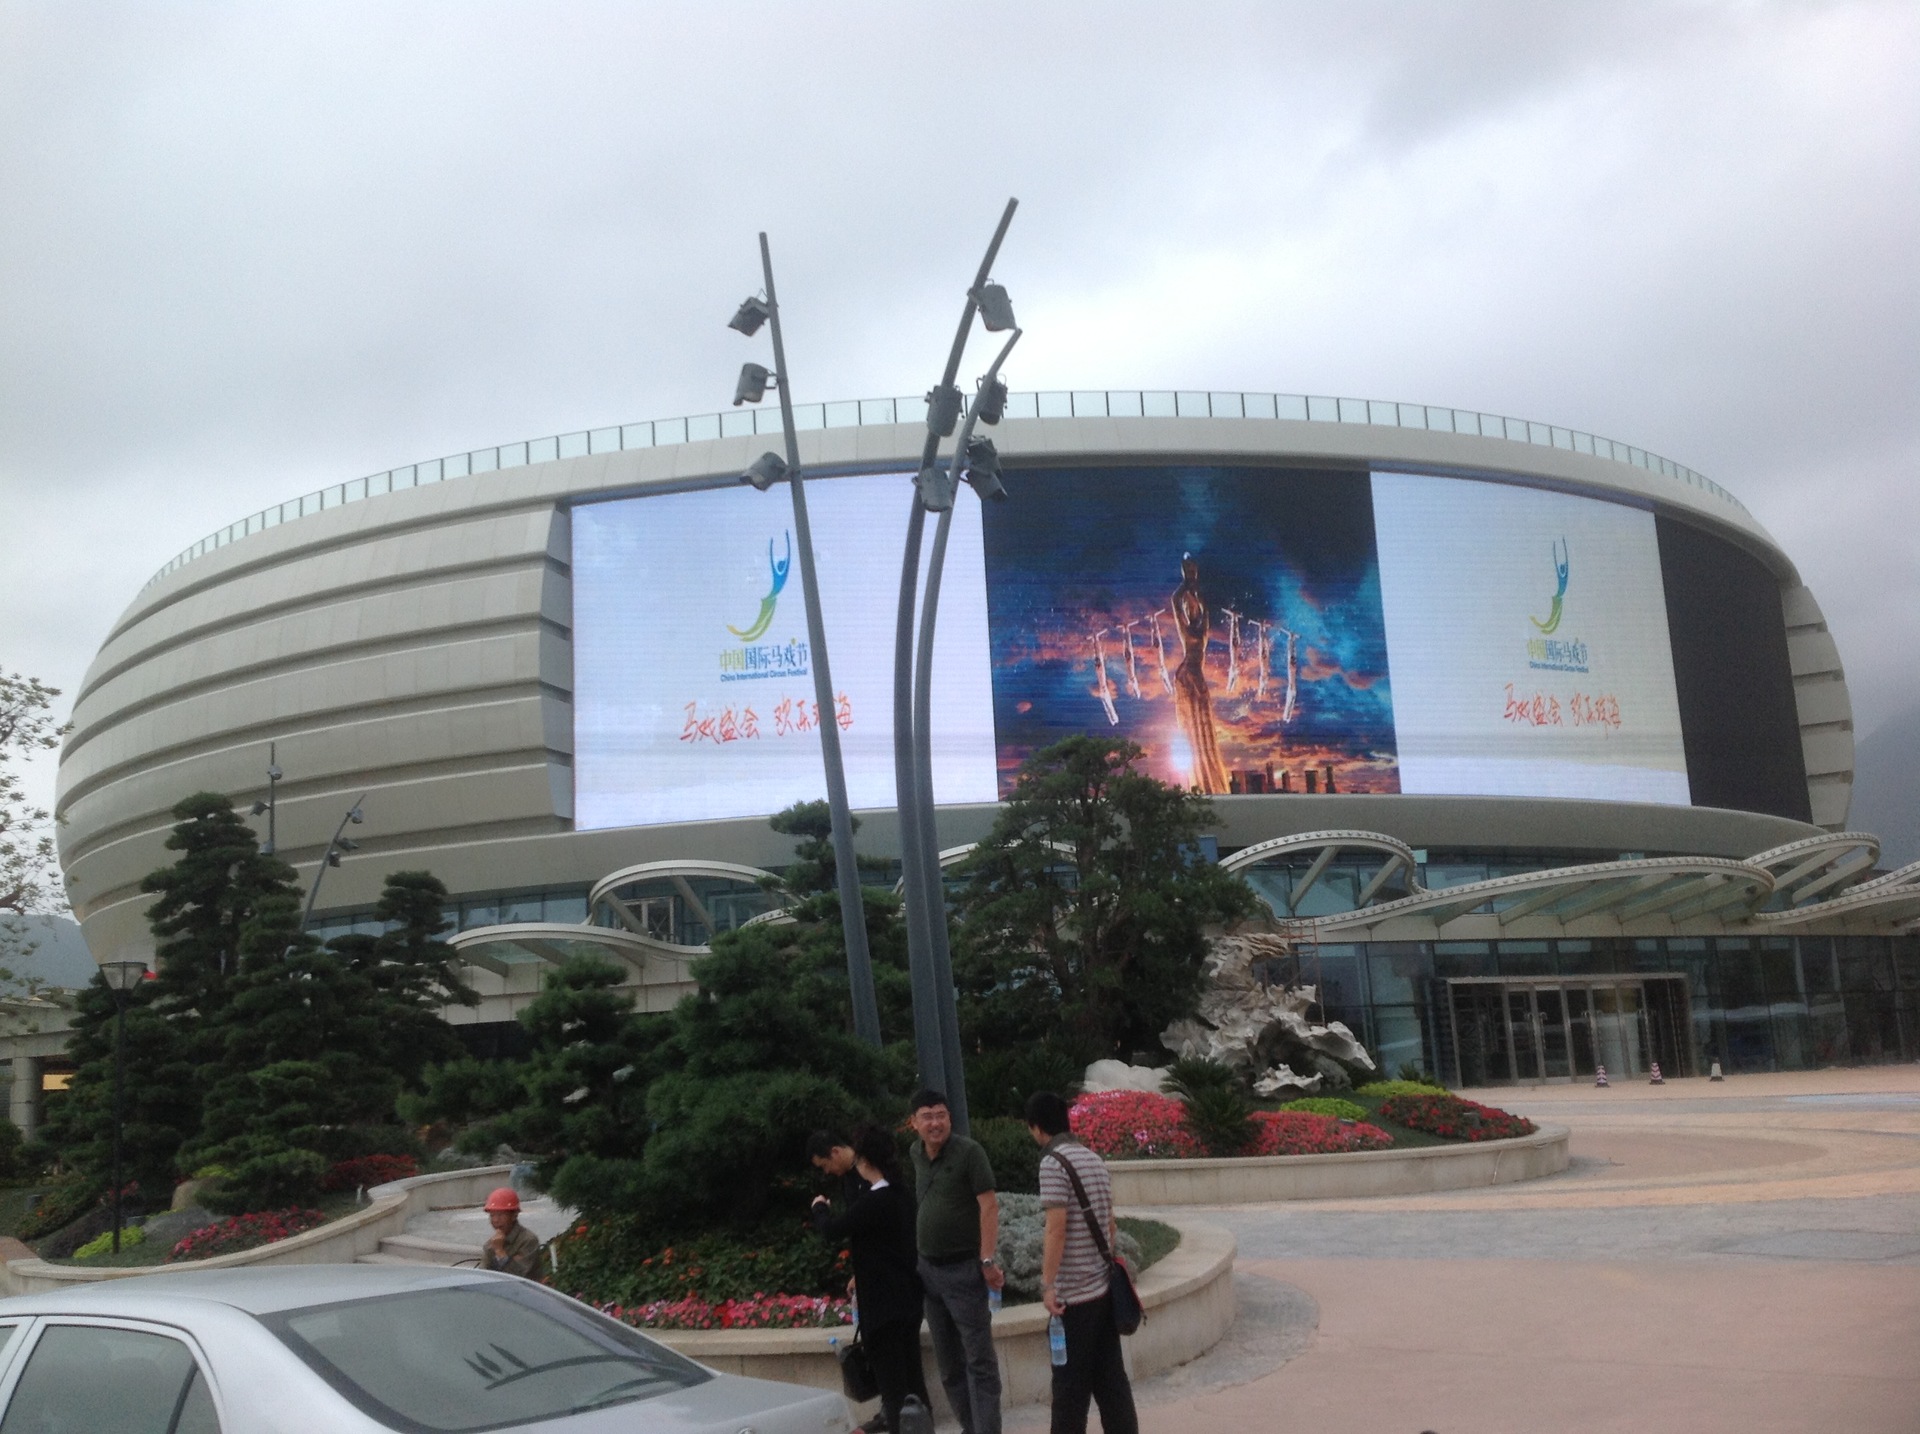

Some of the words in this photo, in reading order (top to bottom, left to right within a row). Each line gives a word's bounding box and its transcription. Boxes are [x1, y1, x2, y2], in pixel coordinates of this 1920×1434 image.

[719, 642, 808, 672] 中国国际马戏节
[720, 673, 736, 682] China
[737, 671, 769, 681] International
[770, 670, 787, 678] Circus
[788, 668, 808, 677] Festival
